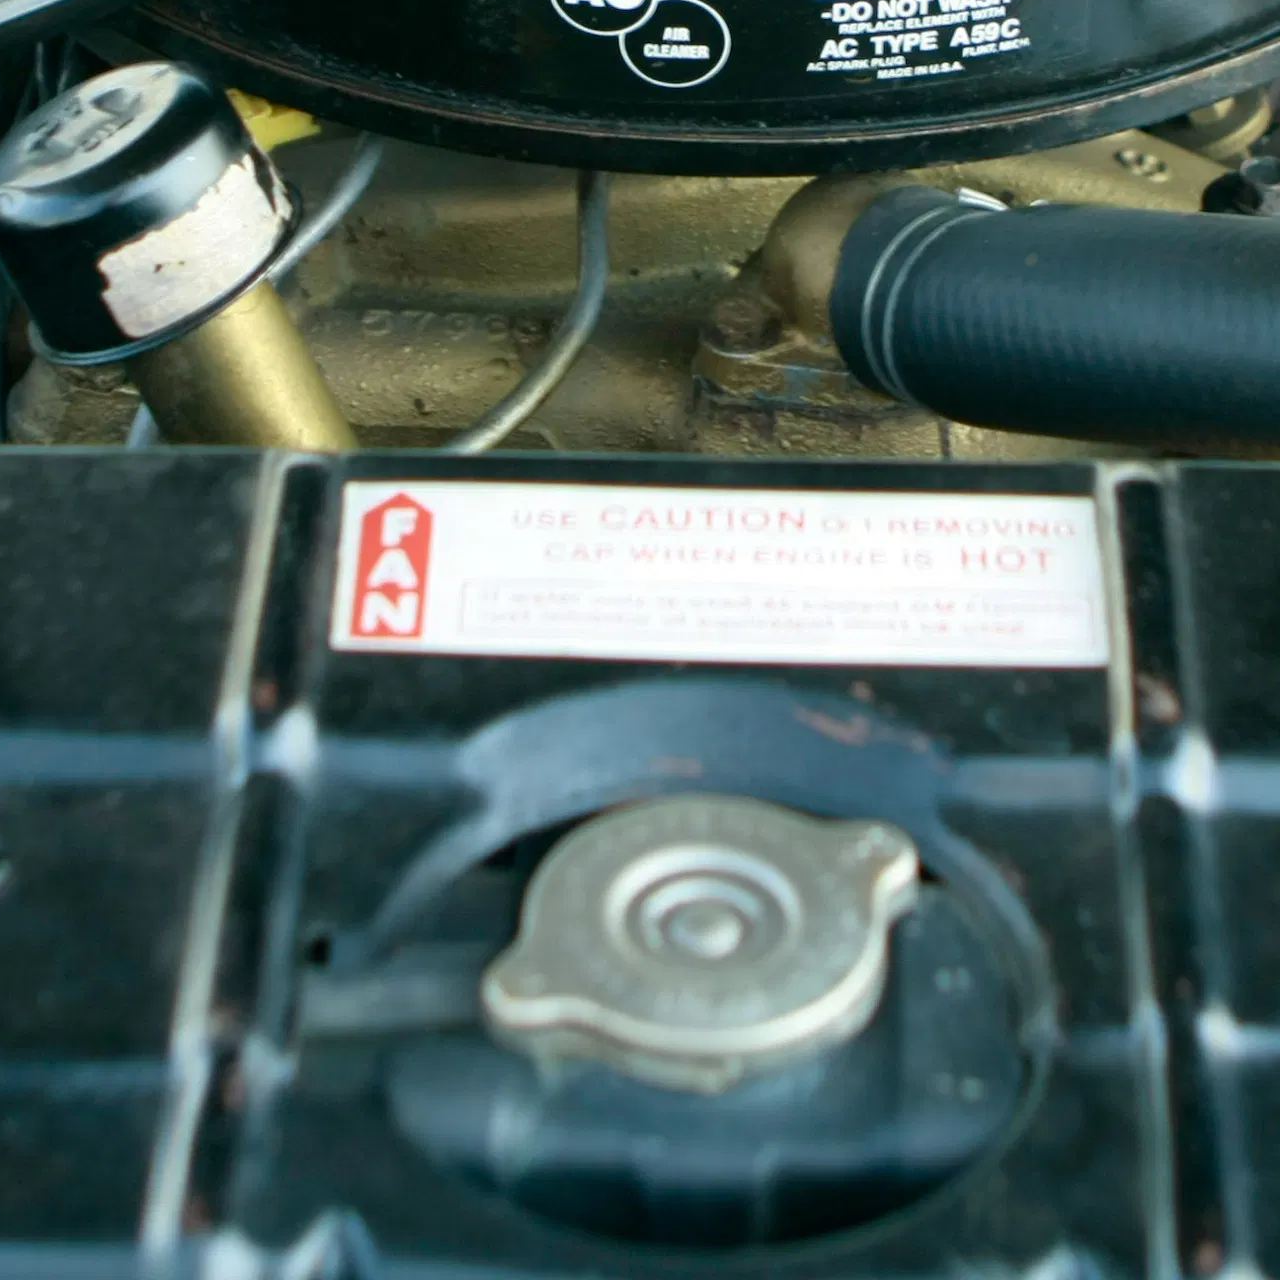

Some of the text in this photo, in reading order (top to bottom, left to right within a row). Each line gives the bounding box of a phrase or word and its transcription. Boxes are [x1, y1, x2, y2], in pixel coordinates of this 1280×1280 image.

[662, 27, 690, 42] AIR
[838, 6, 1006, 35] REPLACE ELEMENT WITH
[643, 43, 710, 59] CLEANER
[820, 38, 859, 59] AC
[870, 30, 939, 55] TYPE
[806, 62, 826, 72] AC
[827, 59, 871, 71] SPARK
[871, 55, 906, 68] PLUG
[877, 66, 913, 79] MADE
[914, 65, 929, 76] IN
[512, 508, 577, 531] USE
[599, 504, 807, 533] CAUTION
[887, 516, 1077, 538] REMOVING
[358, 507, 420, 634] FAN
[543, 541, 1054, 573] CAP WHEN ENGINE IS HOT
